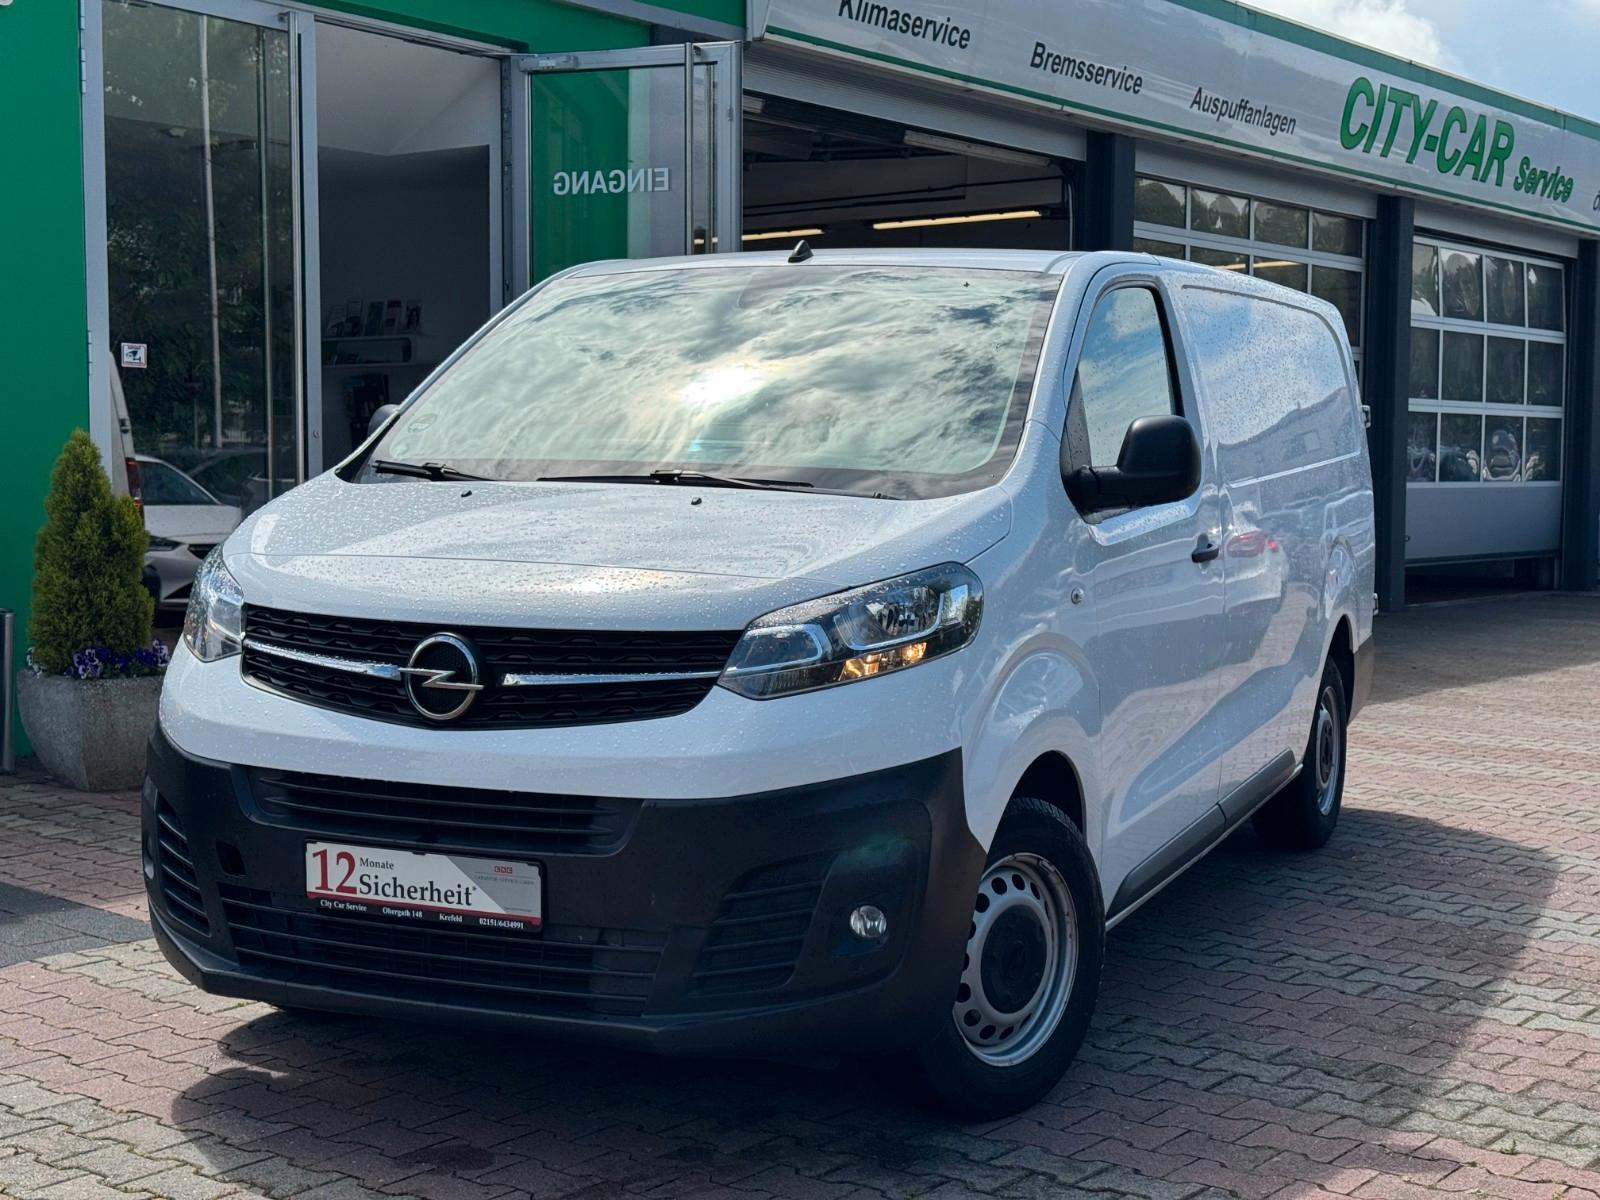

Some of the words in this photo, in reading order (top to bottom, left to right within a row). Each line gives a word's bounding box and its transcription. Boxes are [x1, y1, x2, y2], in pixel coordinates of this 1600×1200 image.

[838, 0, 971, 49] Klimaservice
[1029, 41, 1144, 95] Bremsservice
[1189, 86, 1297, 137] Auspuffanlagen
[1339, 76, 1515, 187] CITY-CAR
[1513, 156, 1574, 204] Service
[312, 848, 358, 895] 12
[359, 857, 395, 871] Monate
[320, 899, 332, 909] City
[333, 901, 345, 909] Car
[346, 902, 368, 912] Service
[439, 913, 463, 923] Krefeld
